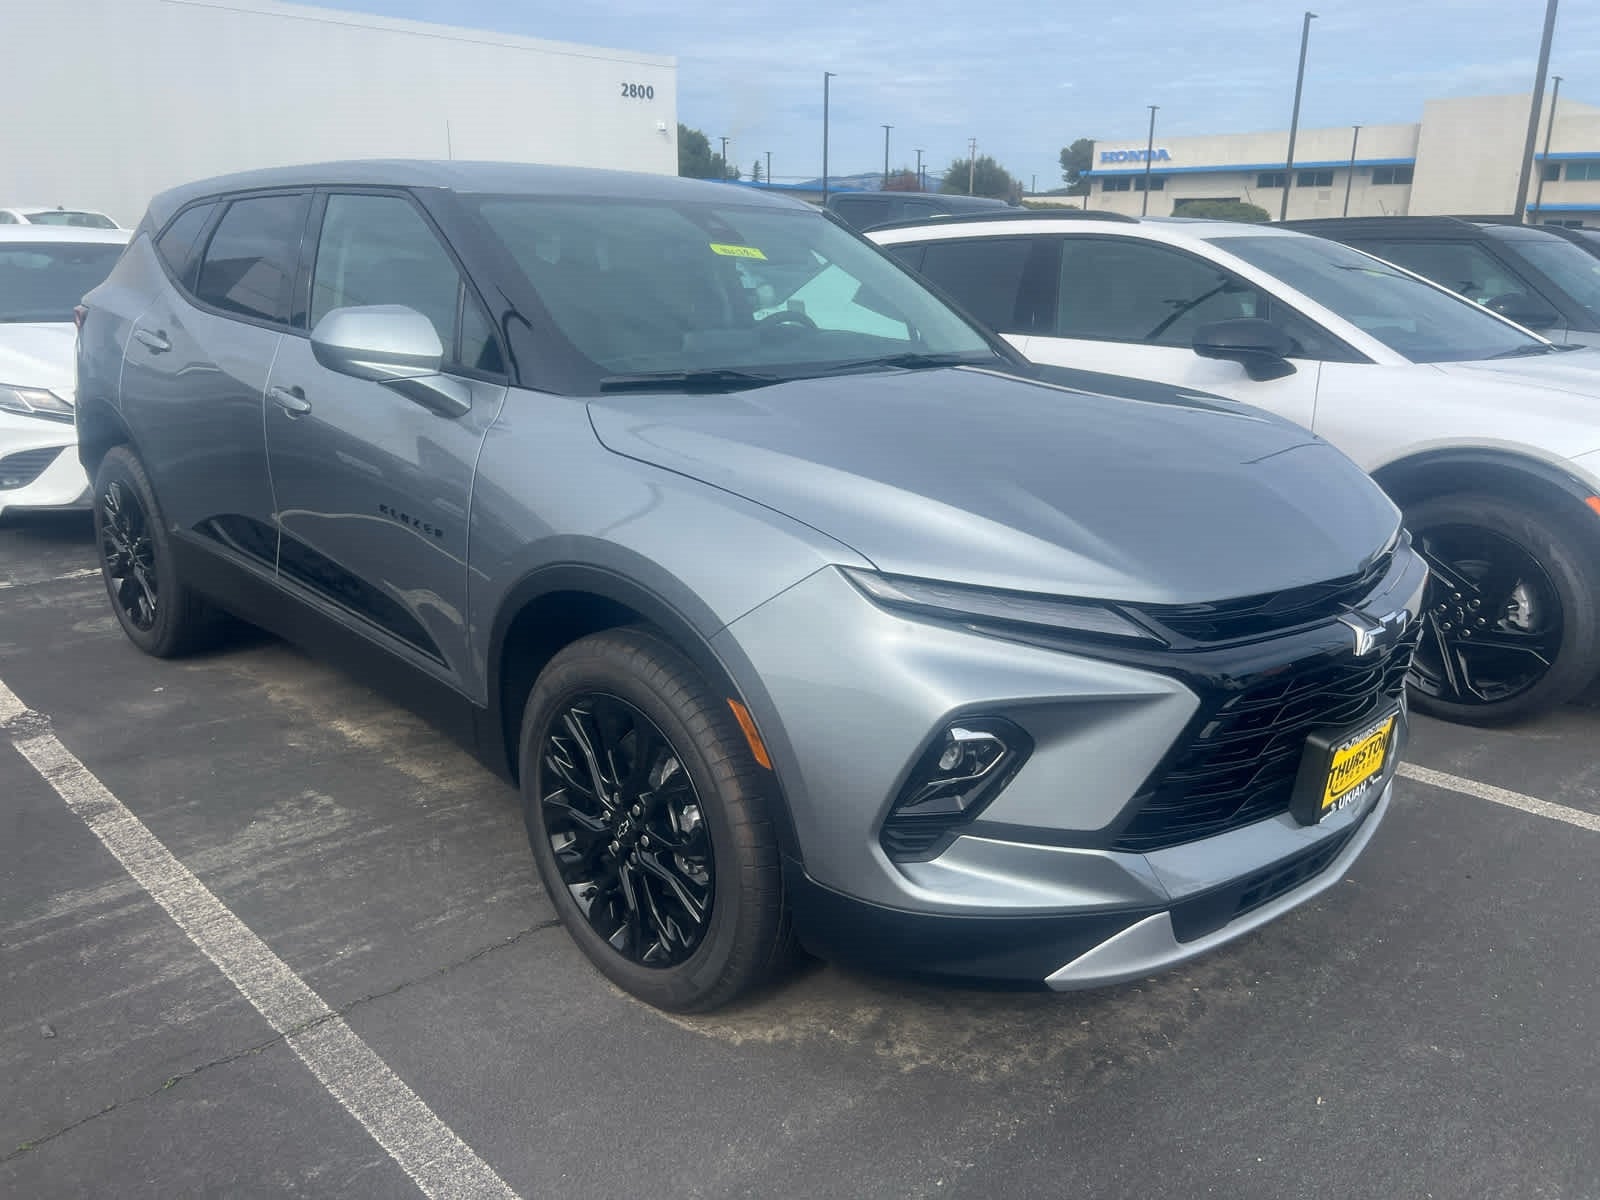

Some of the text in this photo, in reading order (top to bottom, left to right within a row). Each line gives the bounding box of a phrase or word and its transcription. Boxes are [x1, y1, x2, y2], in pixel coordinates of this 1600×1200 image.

[621, 83, 654, 100] 2800
[1101, 149, 1171, 163] HONDA
[1329, 731, 1388, 790] THURSTON
[1338, 780, 1367, 810] UKIAH
